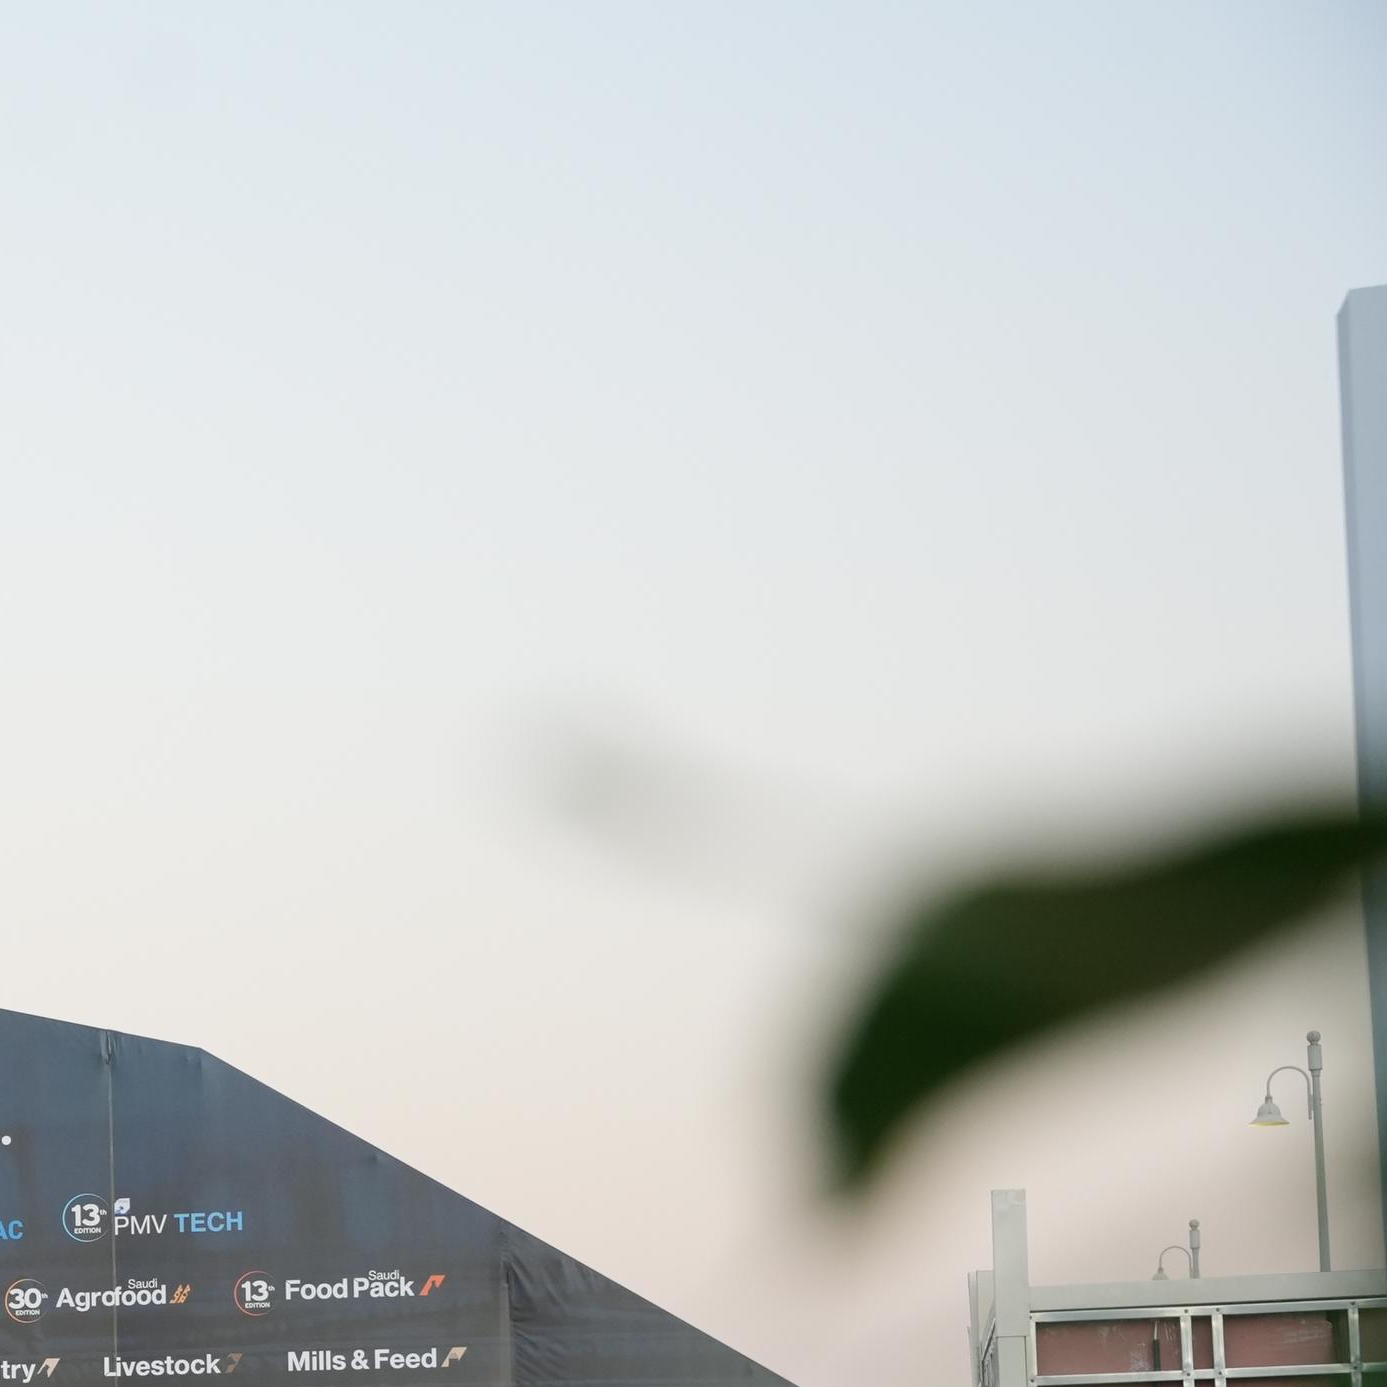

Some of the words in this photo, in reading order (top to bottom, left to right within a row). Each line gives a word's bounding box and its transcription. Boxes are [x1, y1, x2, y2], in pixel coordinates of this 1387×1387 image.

[73, 1226, 102, 1235] EDITION
[114, 1213, 168, 1236] PMV
[173, 1210, 244, 1233] TECH
[127, 1278, 158, 1289] Saudi
[285, 1278, 348, 1301] Food
[353, 1275, 415, 1299] Pack
[367, 1270, 401, 1281] Saudi
[55, 1284, 167, 1312] Agrofood
[244, 1301, 271, 1309] EDITION
[103, 1353, 221, 1378] Livestock
[287, 1350, 346, 1372] Mills
[350, 1349, 370, 1371] &
[374, 1347, 438, 1370] Feed
